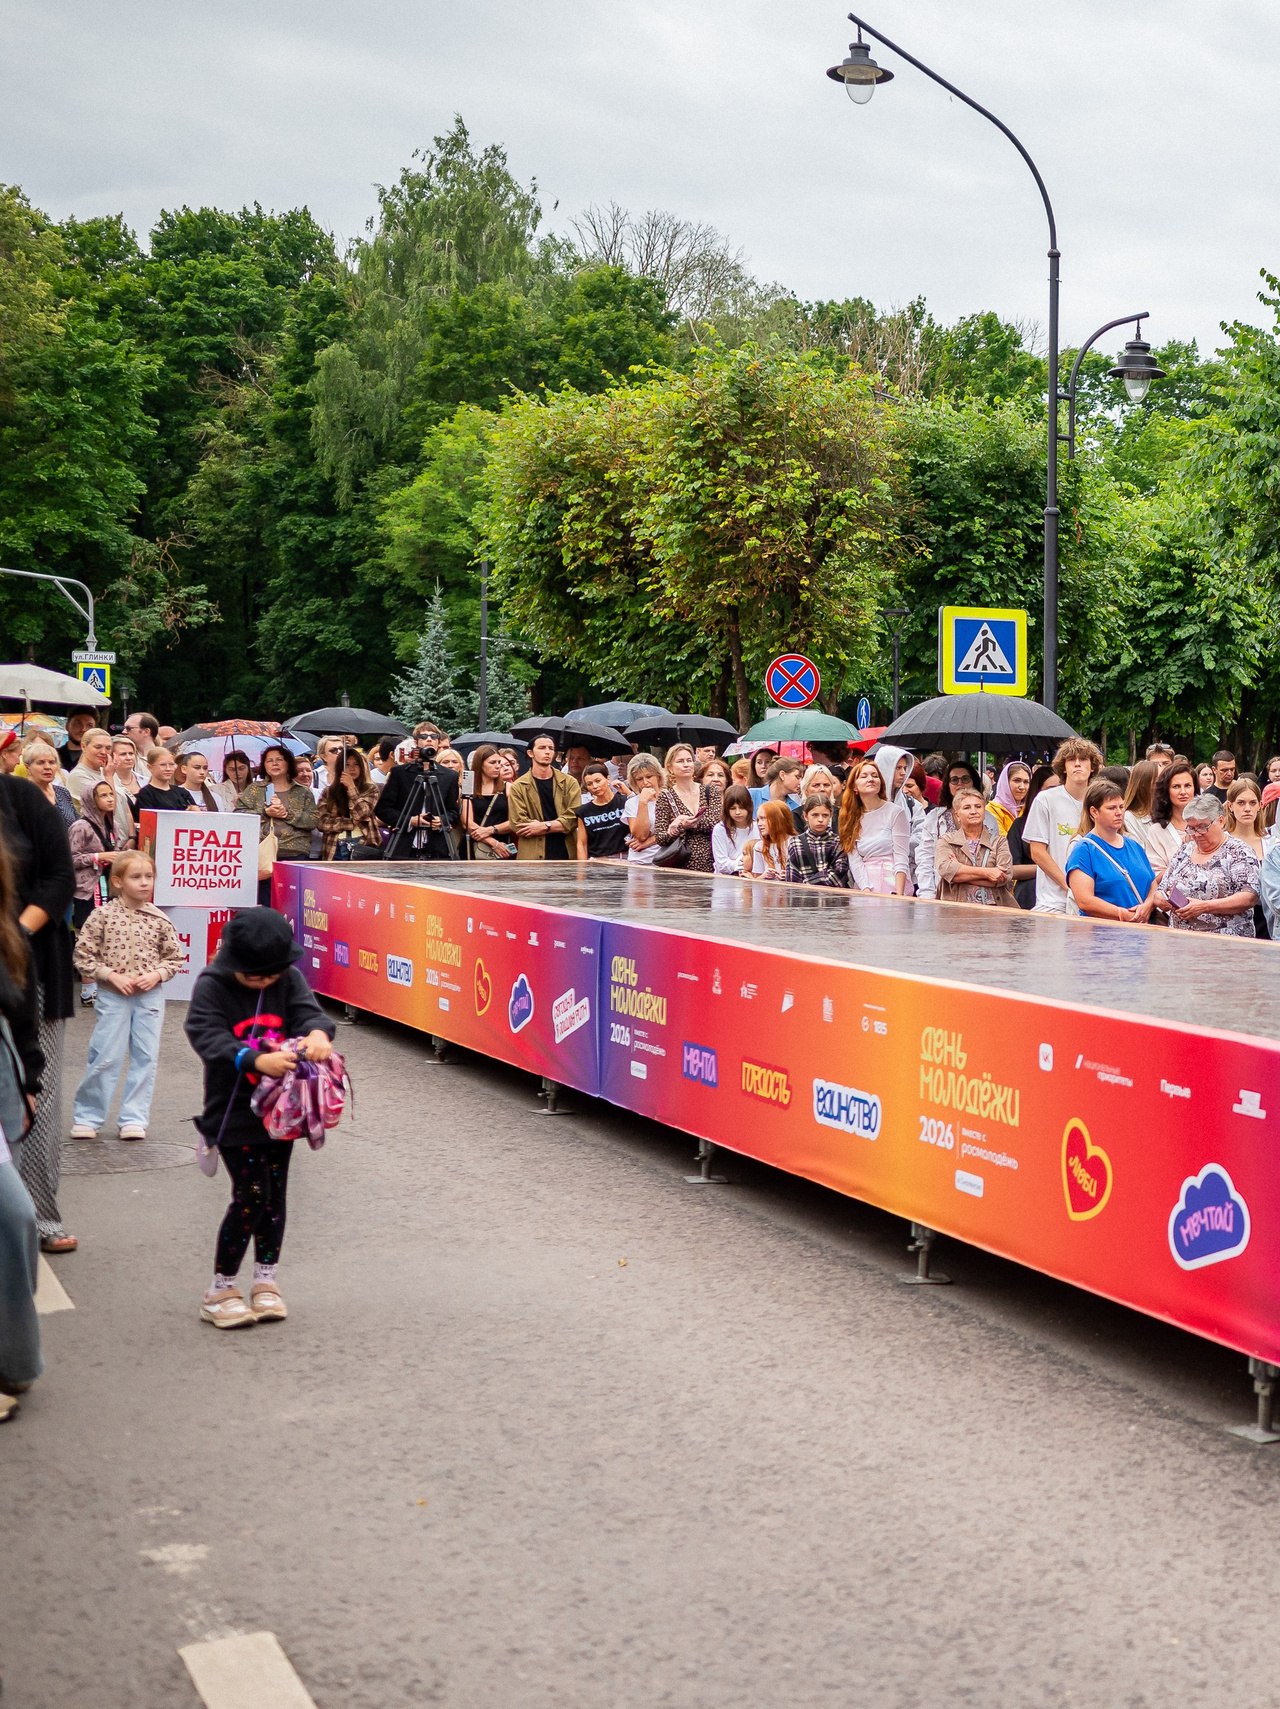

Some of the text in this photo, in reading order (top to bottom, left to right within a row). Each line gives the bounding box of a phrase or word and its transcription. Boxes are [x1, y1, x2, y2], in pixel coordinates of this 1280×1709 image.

[174, 829, 243, 849] ГРАД
[173, 848, 242, 864] ВЕЛИК
[172, 863, 242, 877] И МНОГ
[171, 877, 241, 890] ЛЮДЬМИ
[610, 1022, 631, 1047] 2026
[918, 1115, 955, 1150] 2026
